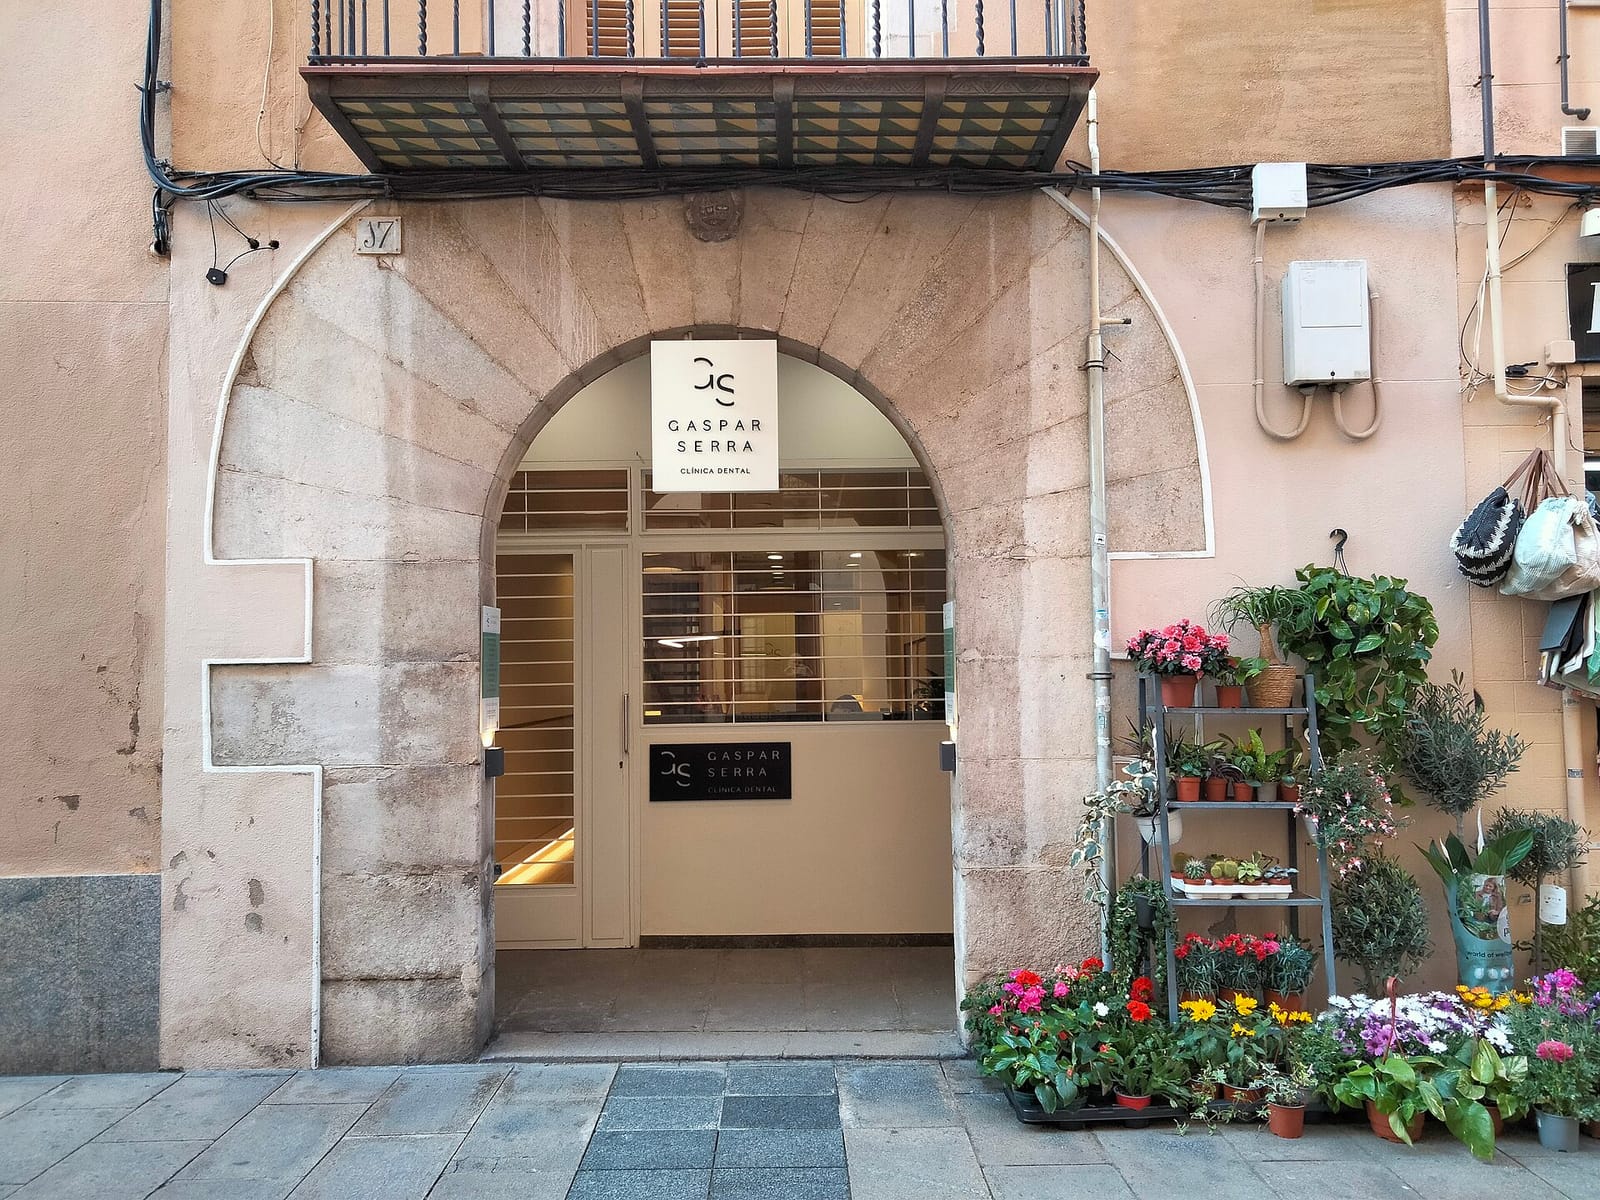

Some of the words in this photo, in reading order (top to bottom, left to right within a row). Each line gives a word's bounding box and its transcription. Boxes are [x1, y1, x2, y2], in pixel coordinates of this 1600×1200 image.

[667, 420, 761, 432] GASPAR
[677, 440, 753, 453] SERRA
[680, 466, 714, 475] CLÍNICA
[717, 467, 751, 475] DENTAL
[707, 750, 780, 761] GASPAR
[707, 767, 767, 778] SERRA
